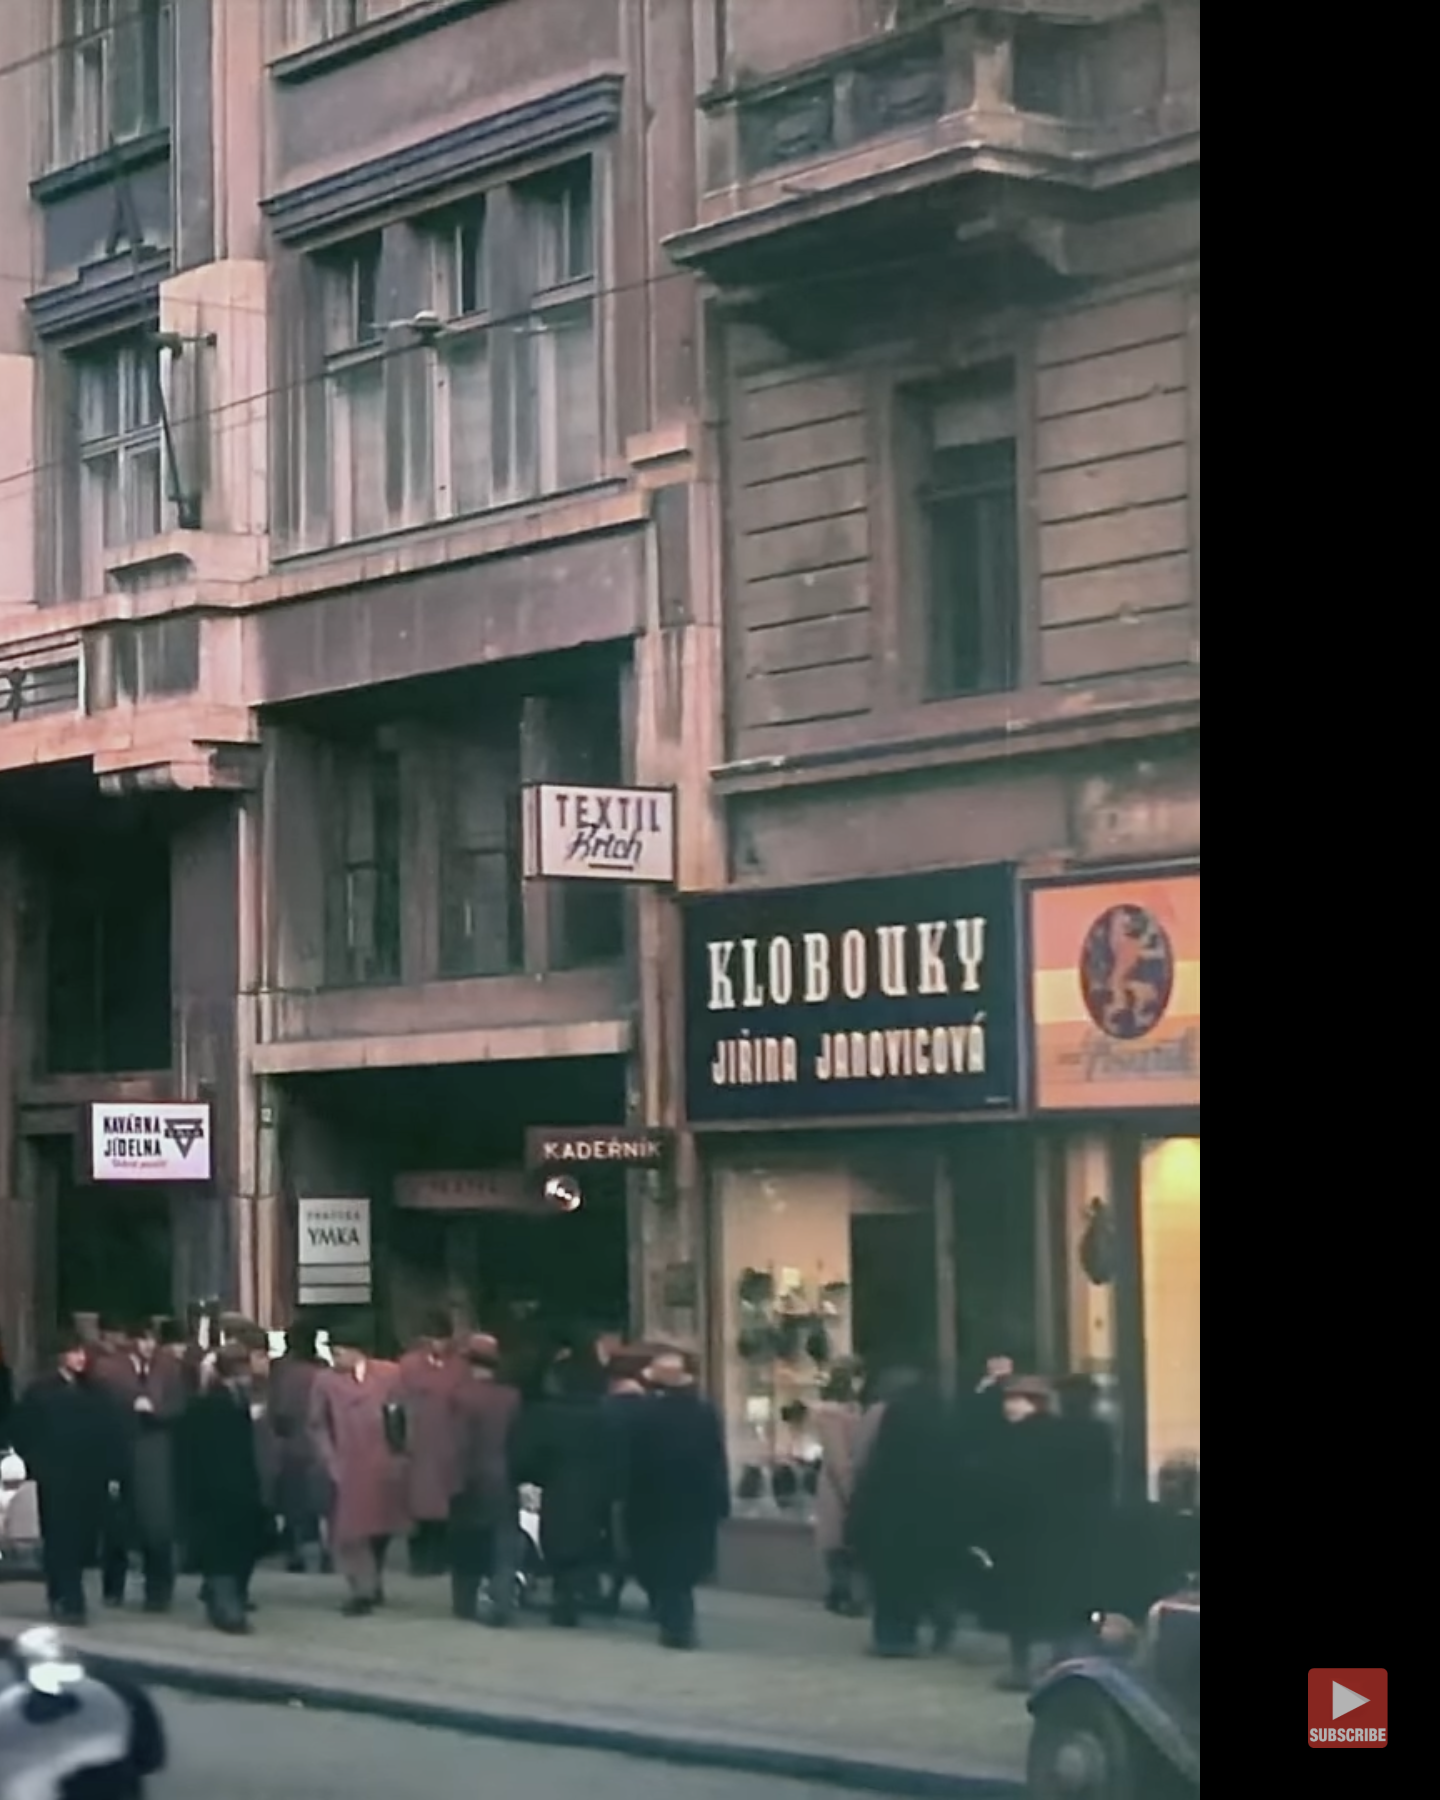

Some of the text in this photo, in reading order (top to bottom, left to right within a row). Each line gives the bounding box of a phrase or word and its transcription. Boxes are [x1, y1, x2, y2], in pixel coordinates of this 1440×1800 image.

[556, 794, 661, 832] TEXTIL
[707, 917, 987, 1010] KLOBOUKY
[103, 1113, 161, 1134] KAVÁRNA
[104, 1137, 162, 1157] JÍDELNA
[307, 1226, 360, 1247] YMKA
